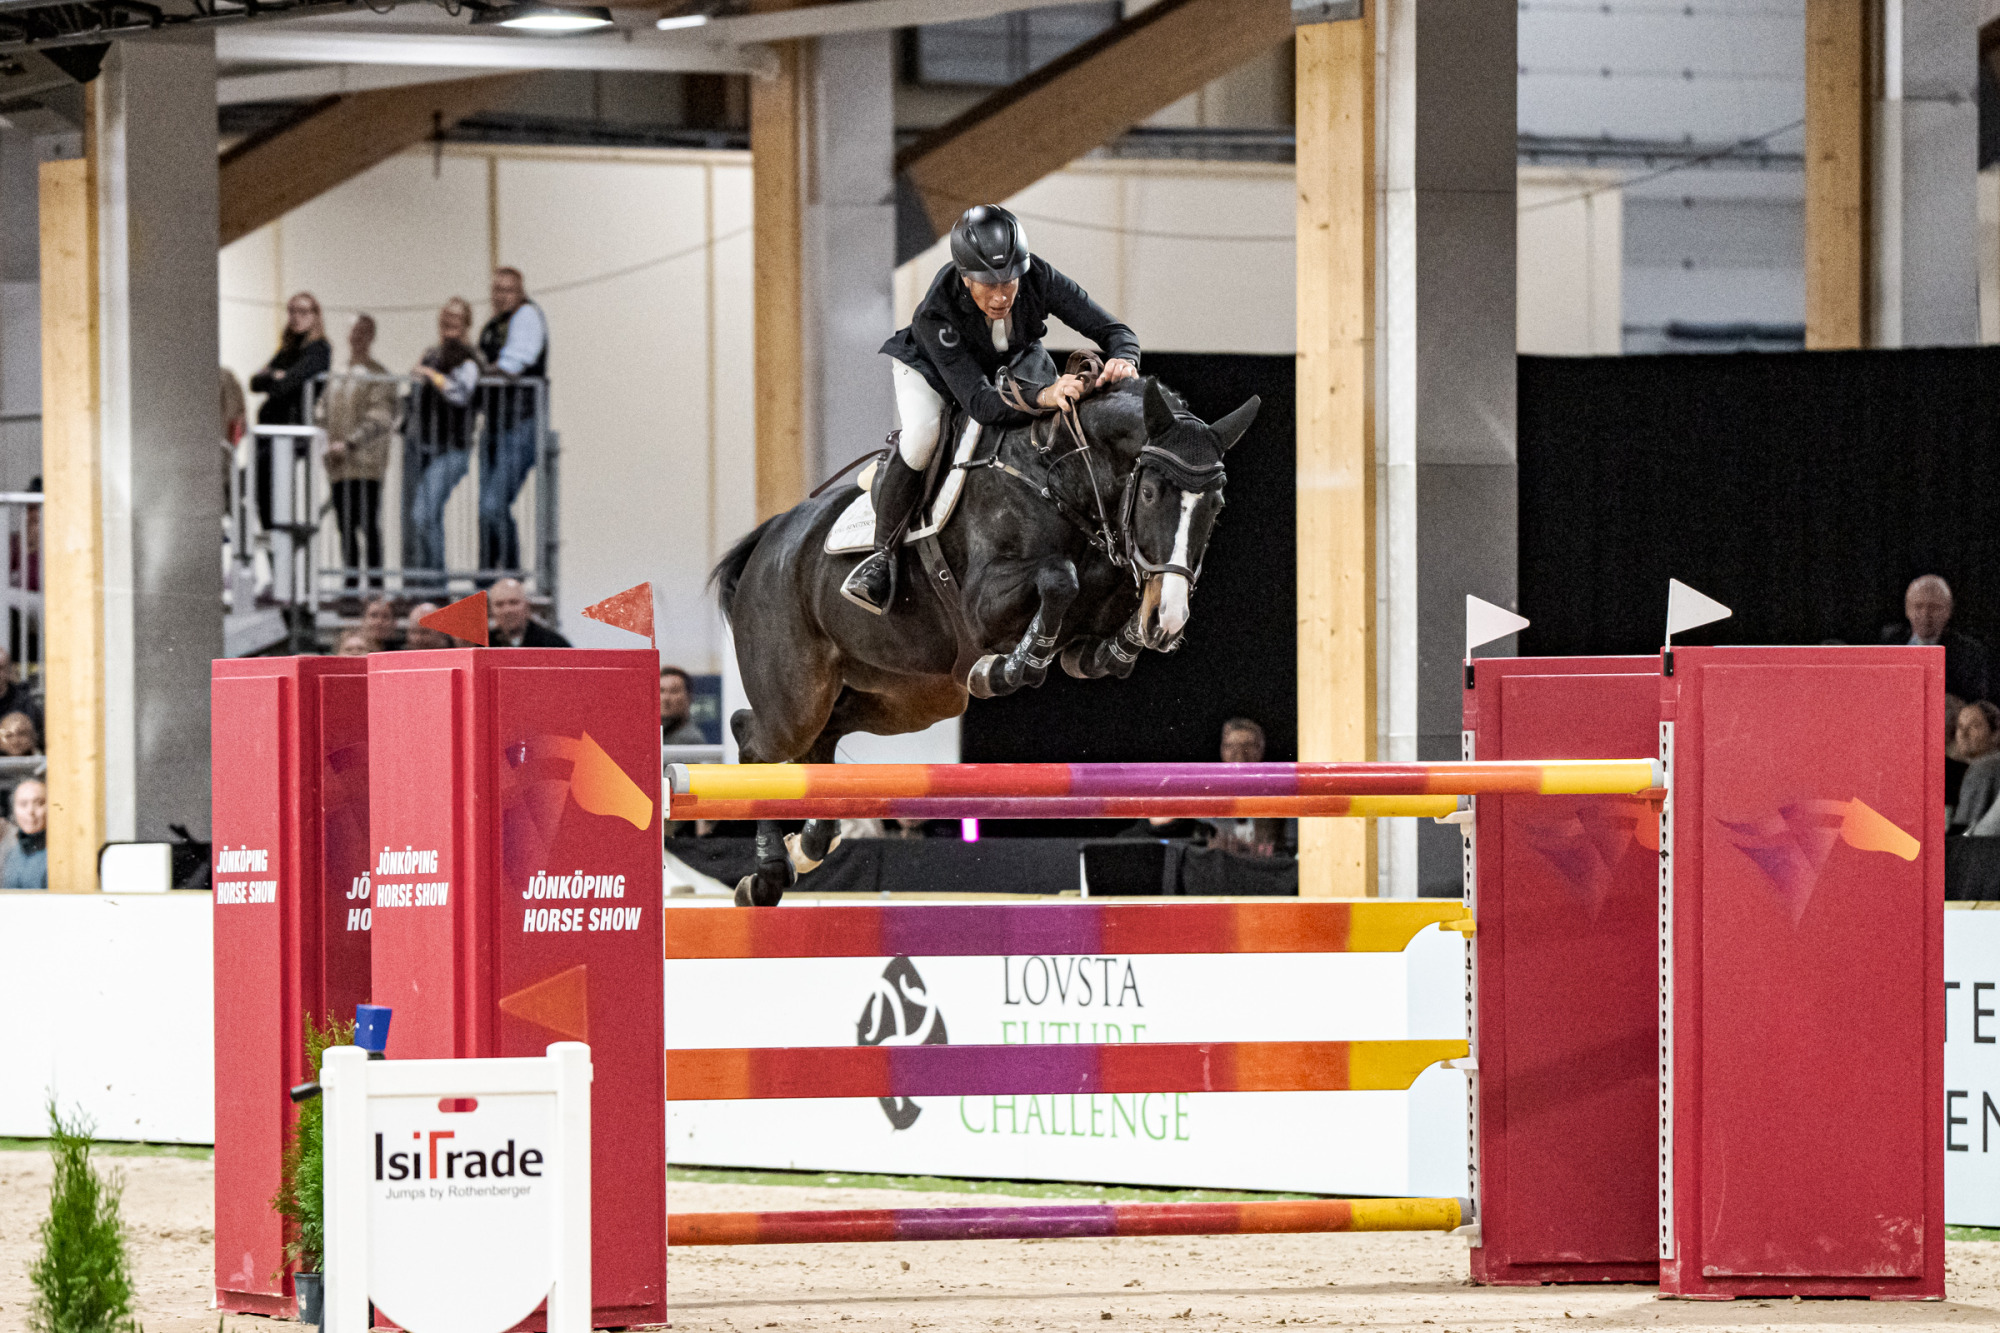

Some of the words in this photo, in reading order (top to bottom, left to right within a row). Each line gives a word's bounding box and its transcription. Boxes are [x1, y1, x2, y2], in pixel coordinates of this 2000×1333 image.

[216, 845, 268, 873] JÖNKÖPING
[376, 845, 438, 875] JÖNKÖPING
[217, 881, 247, 904] HORSE
[249, 881, 277, 904] SHOW
[376, 883, 413, 908] HORSE
[415, 882, 449, 907] SHOW
[522, 870, 625, 899] JÖNKÖPING
[523, 908, 584, 932] HORSE
[588, 907, 642, 931] SHOW
[960, 1093, 1190, 1141] CHALLENGE
[386, 1187, 426, 1201] Jumps
[430, 1187, 444, 1200] by
[448, 1184, 531, 1198] Rothenberger
